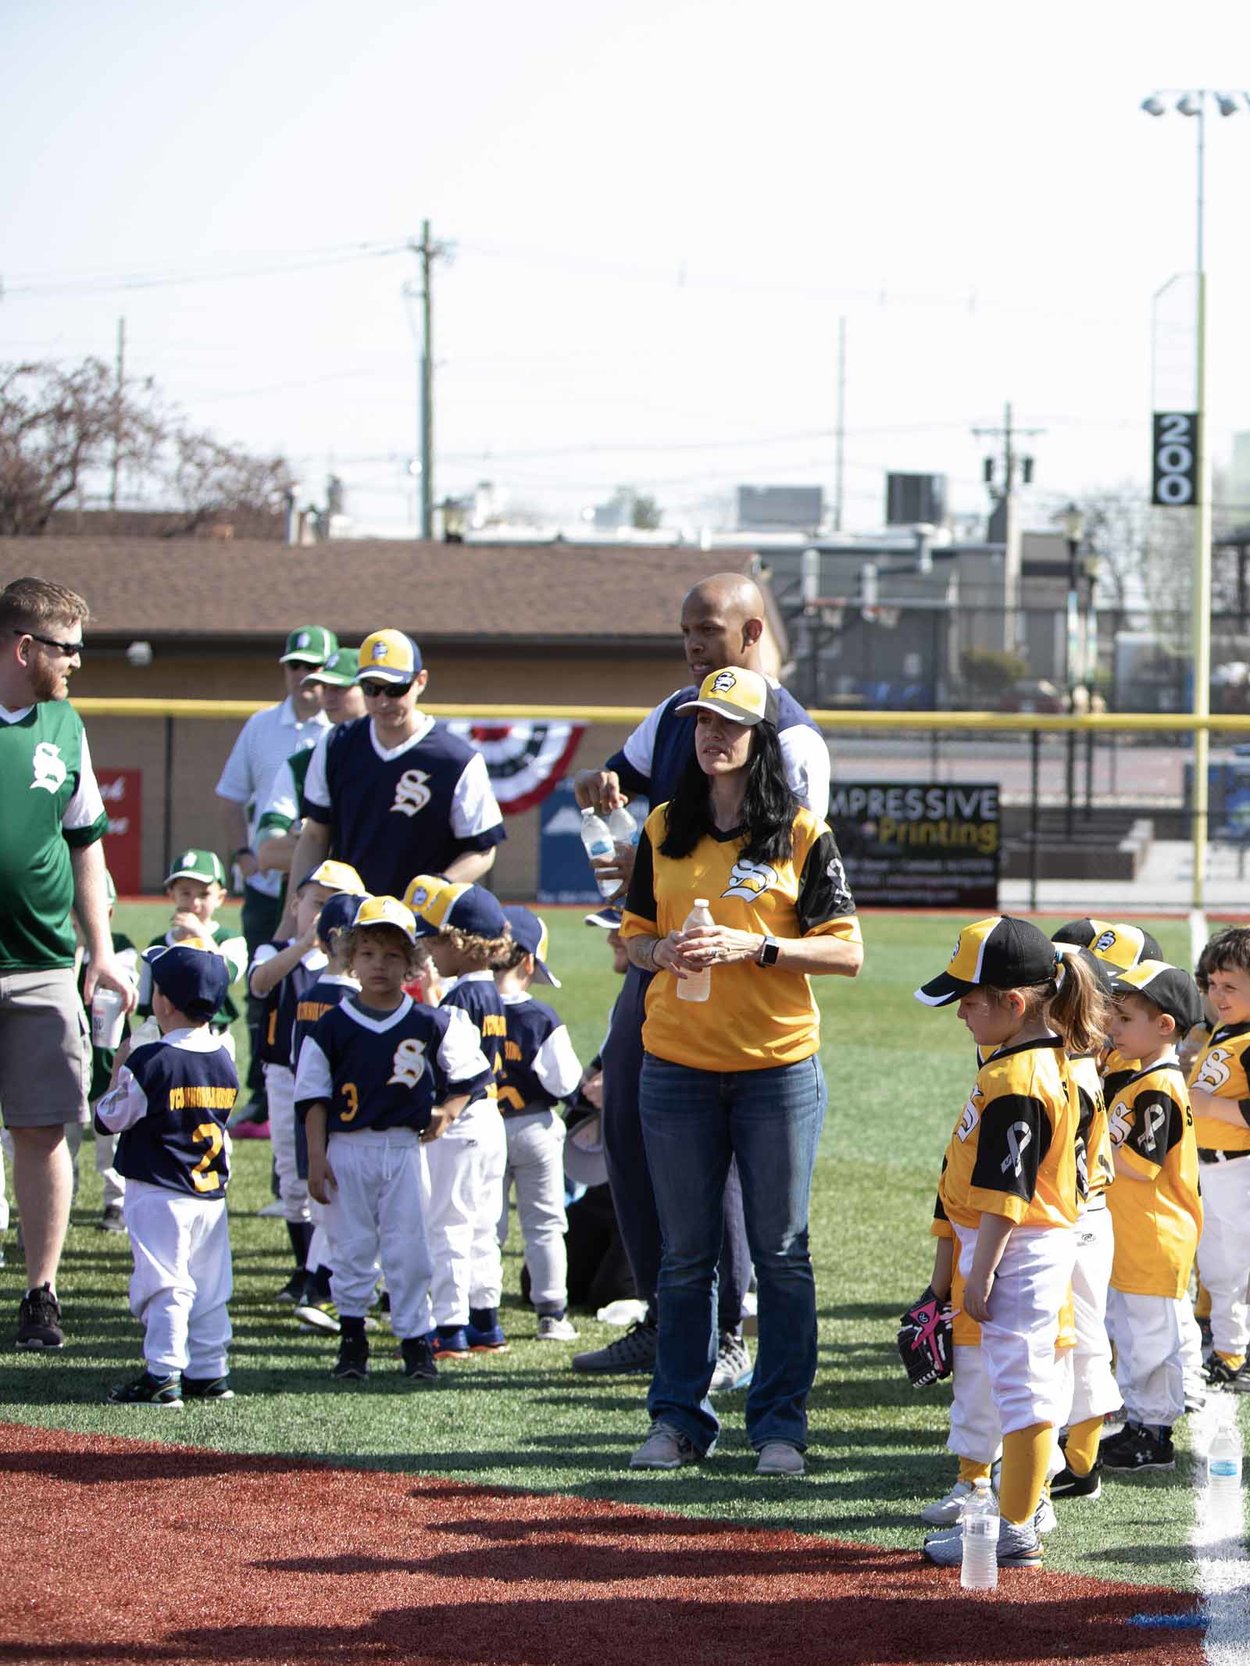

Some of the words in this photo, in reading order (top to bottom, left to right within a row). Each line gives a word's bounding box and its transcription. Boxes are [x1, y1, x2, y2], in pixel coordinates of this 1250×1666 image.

[1157, 414, 1192, 505] 200
[30, 741, 67, 794] S
[390, 769, 432, 817] S
[829, 786, 999, 821] MPRESSIVE
[879, 816, 998, 854] Printing
[385, 1038, 427, 1089] S
[1191, 1048, 1234, 1095] S
[340, 1082, 358, 1122] 3
[192, 1122, 224, 1192] 2
